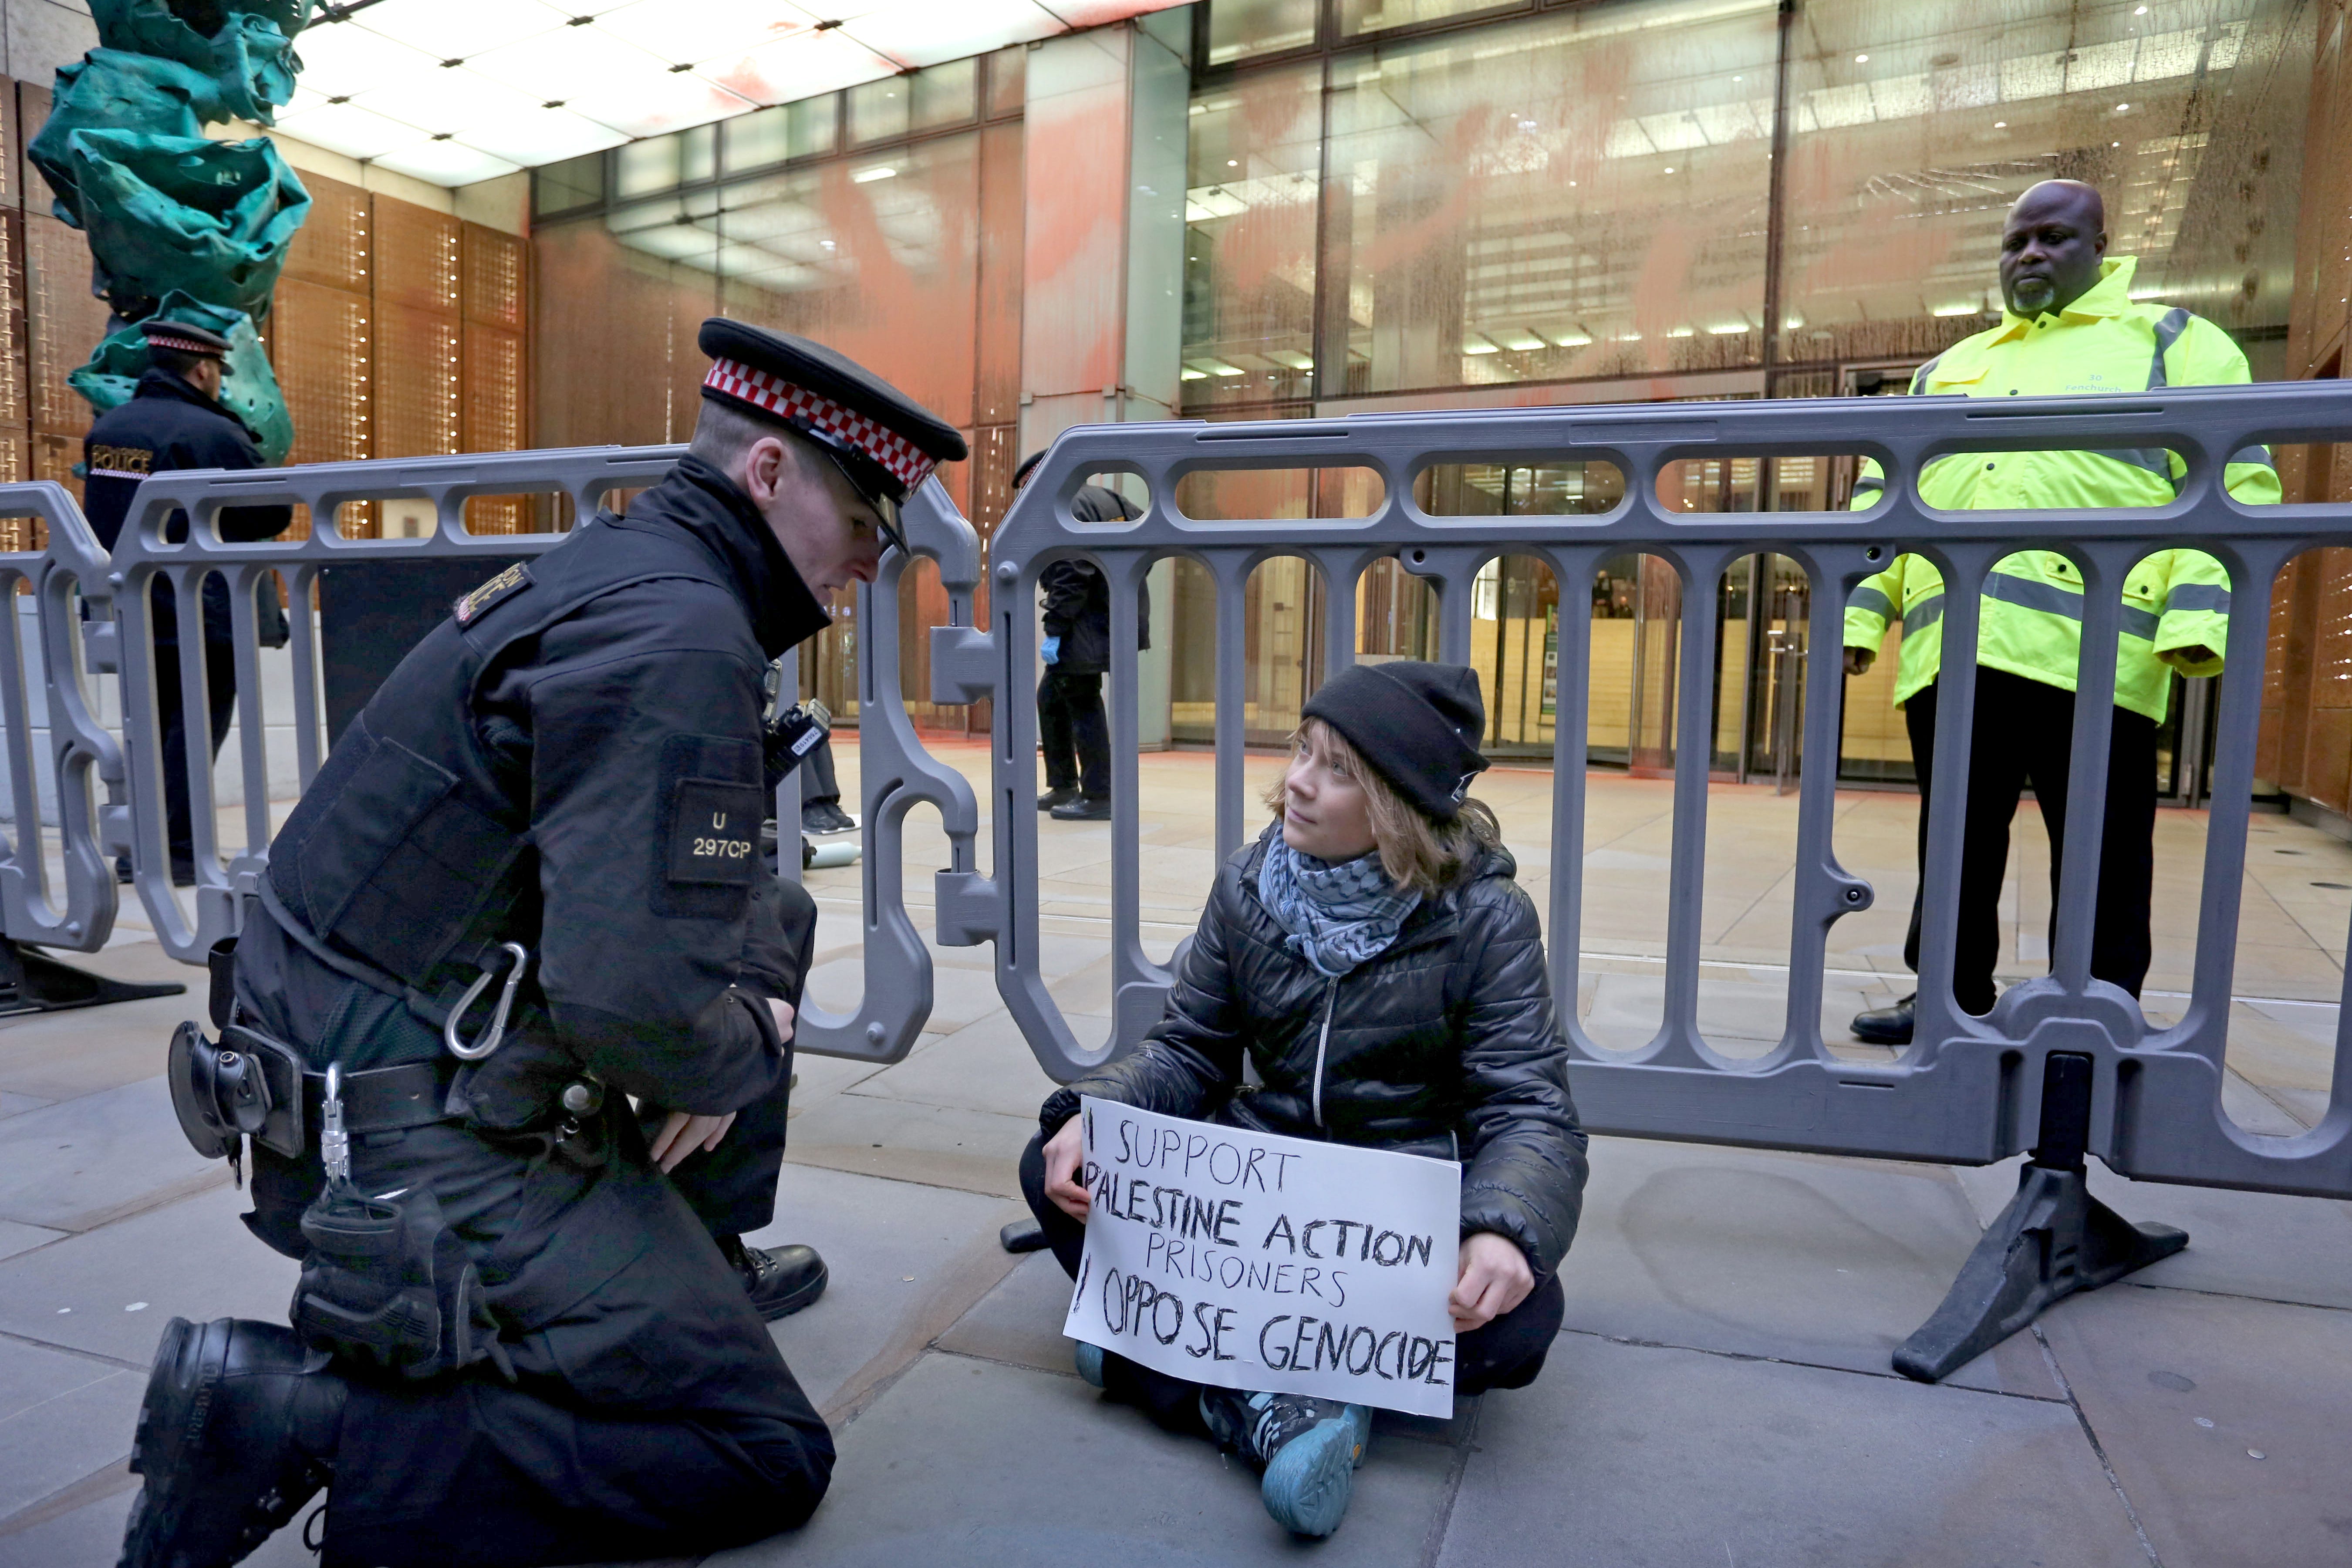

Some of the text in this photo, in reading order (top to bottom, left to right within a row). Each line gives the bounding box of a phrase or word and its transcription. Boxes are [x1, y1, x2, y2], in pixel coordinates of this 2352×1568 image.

[2065, 384, 2122, 393] Fenchurch
[91, 452, 150, 473] POLICE
[712, 812, 726, 830] U
[693, 838, 751, 859] 297CP
[1115, 1120, 1302, 1193] SUPPORT
[1083, 1161, 1433, 1267] PALESTINE ACTION
[1146, 1232, 1349, 1307] PRISONERS
[1103, 1267, 1238, 1362] OPPOSE
[1259, 1314, 1455, 1385] GENOCIDE
